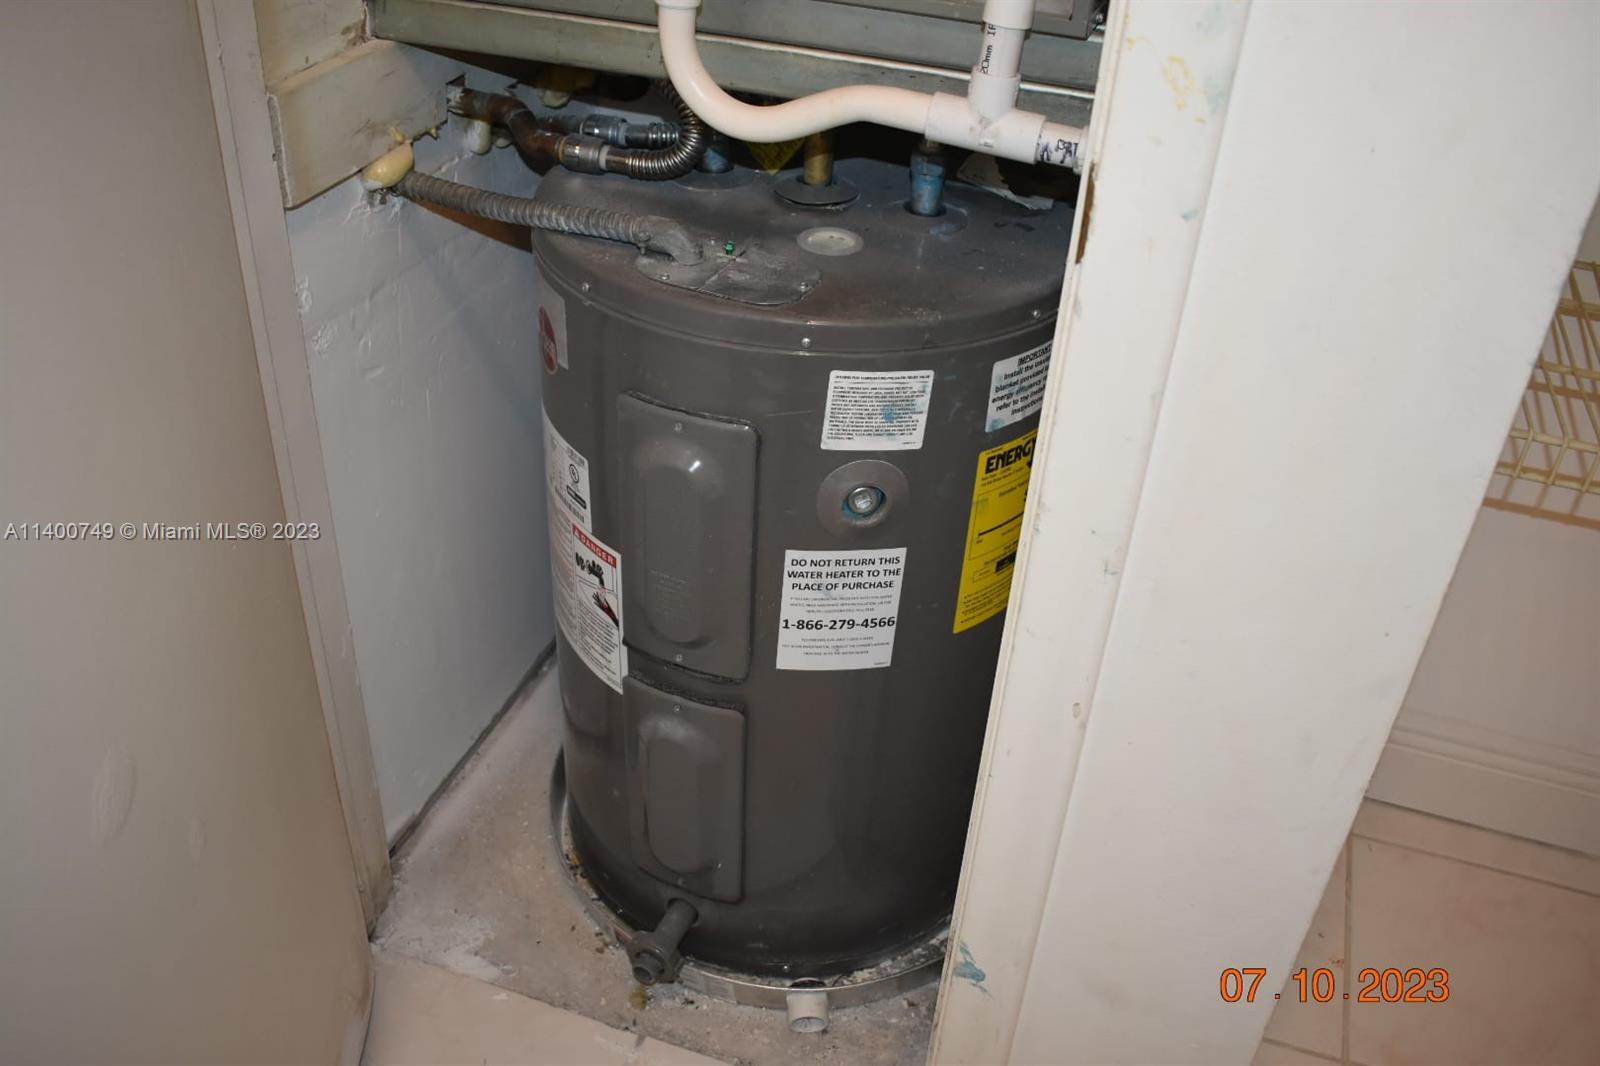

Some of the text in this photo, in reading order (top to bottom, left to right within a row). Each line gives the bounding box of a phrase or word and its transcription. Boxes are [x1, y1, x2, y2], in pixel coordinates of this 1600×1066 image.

[580, 533, 616, 567] DANGER
[790, 555, 901, 568] DO NOT RETURN THIS
[787, 567, 902, 580] WATER HEATER TO THE
[791, 580, 896, 592] PLACE OF PURCHASE
[781, 616, 896, 631] 1-866-279-4566
